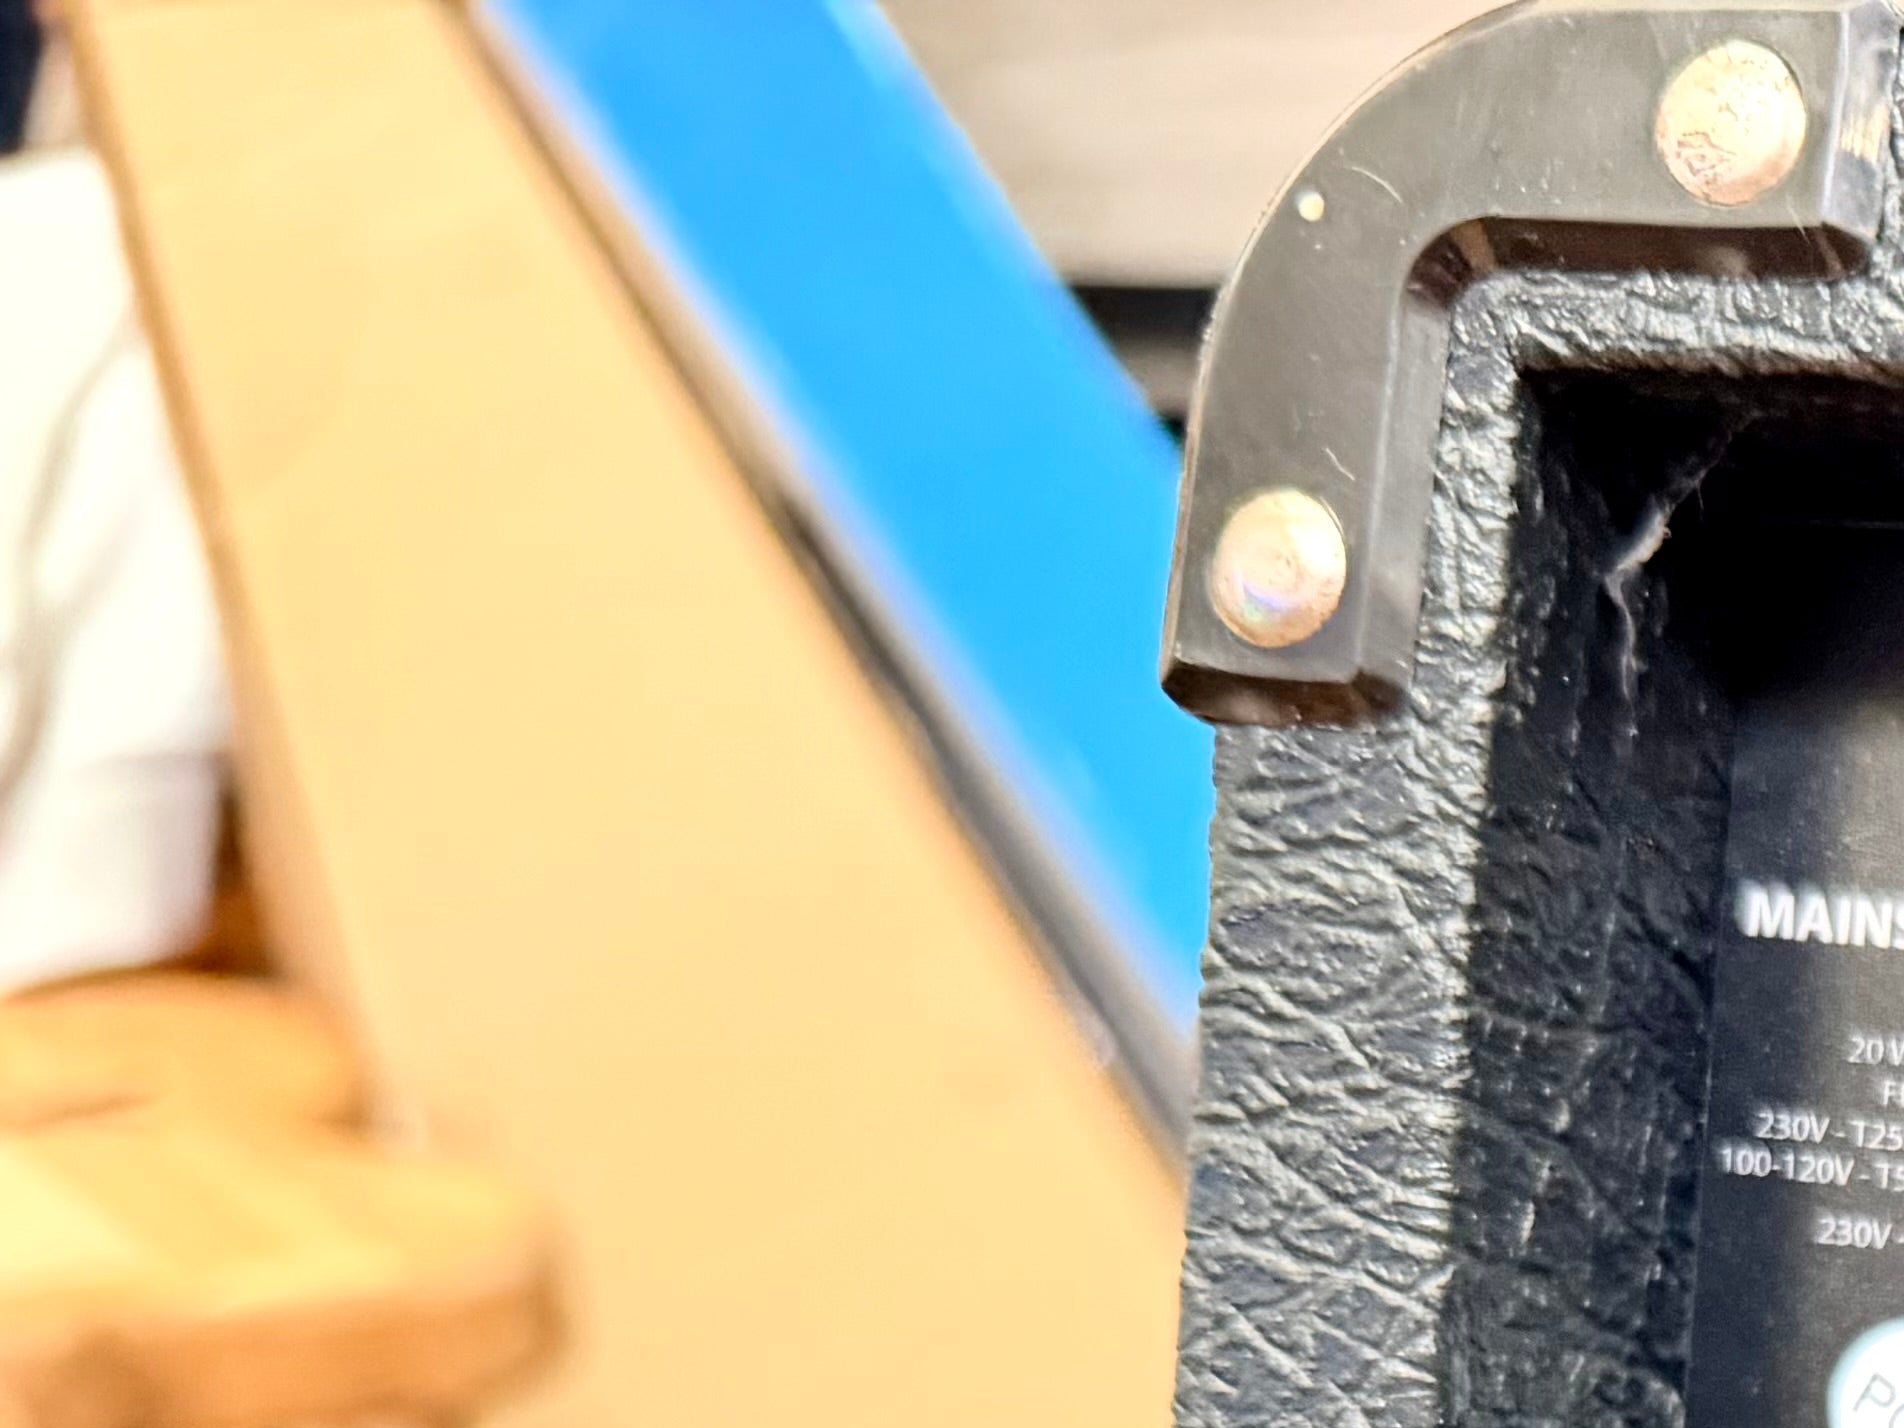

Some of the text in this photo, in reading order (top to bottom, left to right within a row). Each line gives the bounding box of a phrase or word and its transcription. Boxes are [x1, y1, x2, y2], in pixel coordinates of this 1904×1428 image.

[1847, 1035, 1884, 1065] 20
[1754, 1110, 1830, 1144] 230V
[1814, 1216, 1892, 1249] 230V
